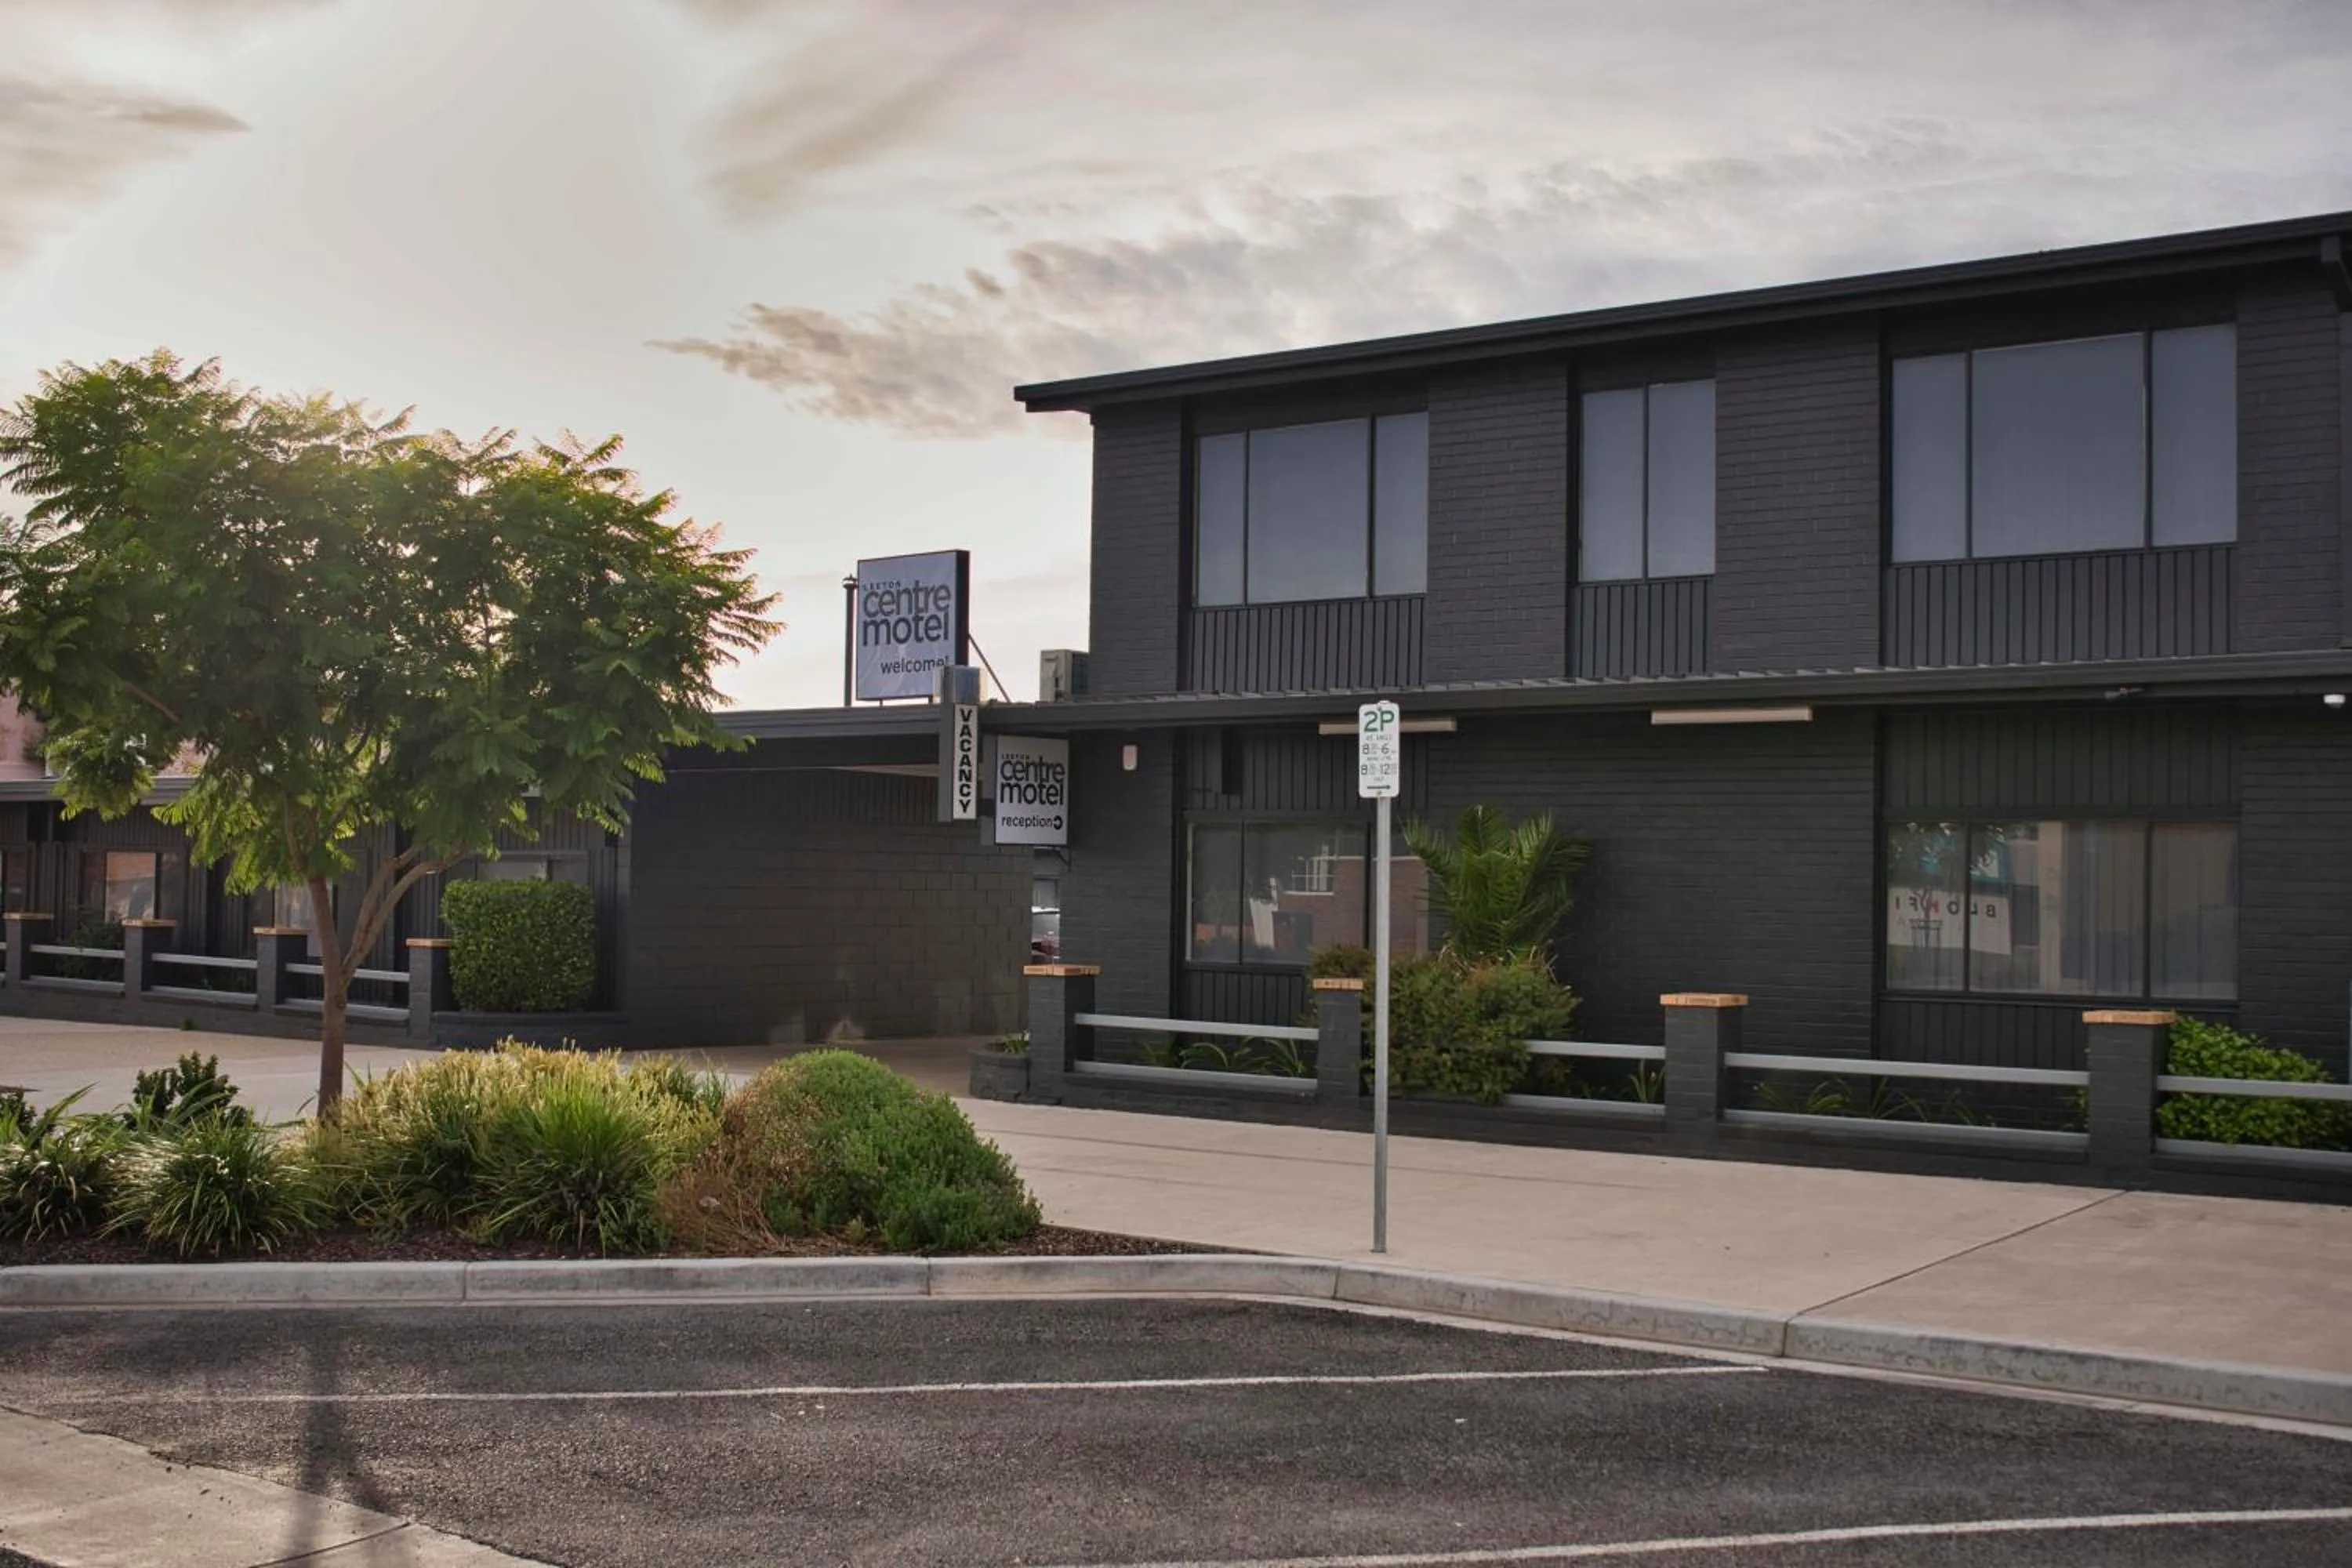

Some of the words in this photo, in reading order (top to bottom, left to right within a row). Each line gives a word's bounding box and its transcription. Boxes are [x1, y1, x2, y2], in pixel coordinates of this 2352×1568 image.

[864, 580, 951, 618] centre
[862, 611, 949, 647] motel
[1364, 710, 1395, 731] 2P
[959, 709, 972, 813] VACANCY
[1000, 755, 1065, 783] centre
[1000, 780, 1063, 805] motel
[1001, 815, 1053, 829] reception
